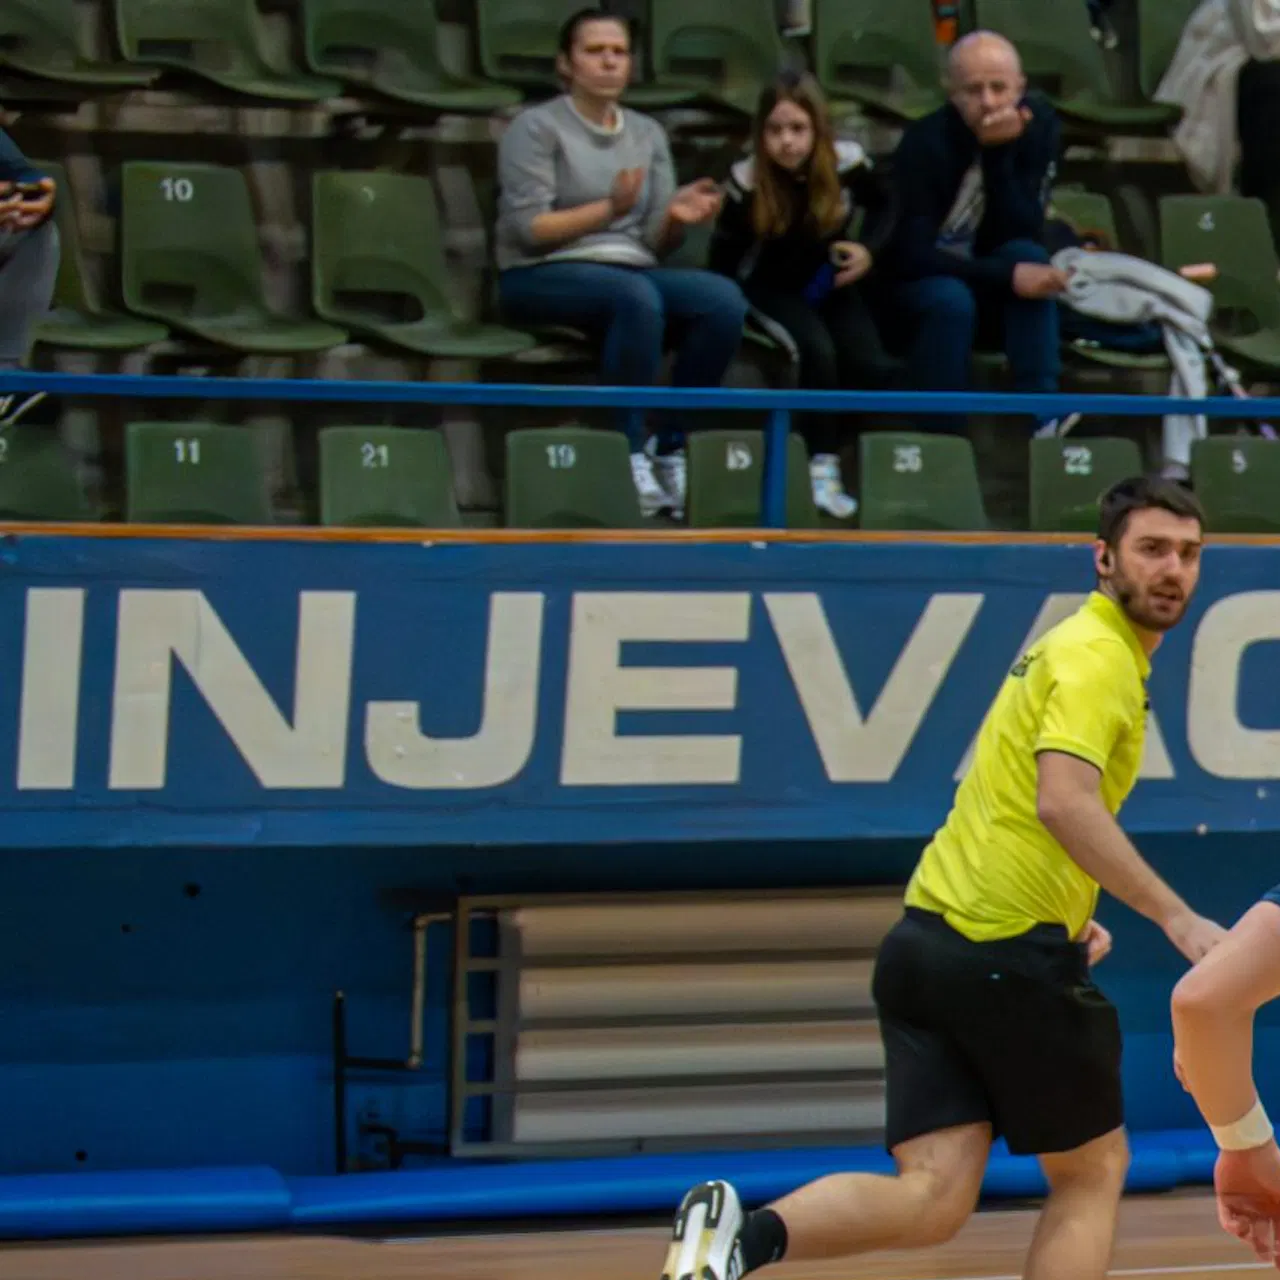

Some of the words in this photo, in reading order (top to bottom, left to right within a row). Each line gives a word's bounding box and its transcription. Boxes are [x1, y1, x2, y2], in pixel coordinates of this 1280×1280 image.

[160, 177, 194, 202] 10
[173, 437, 200, 464] 11
[360, 441, 389, 469] 21
